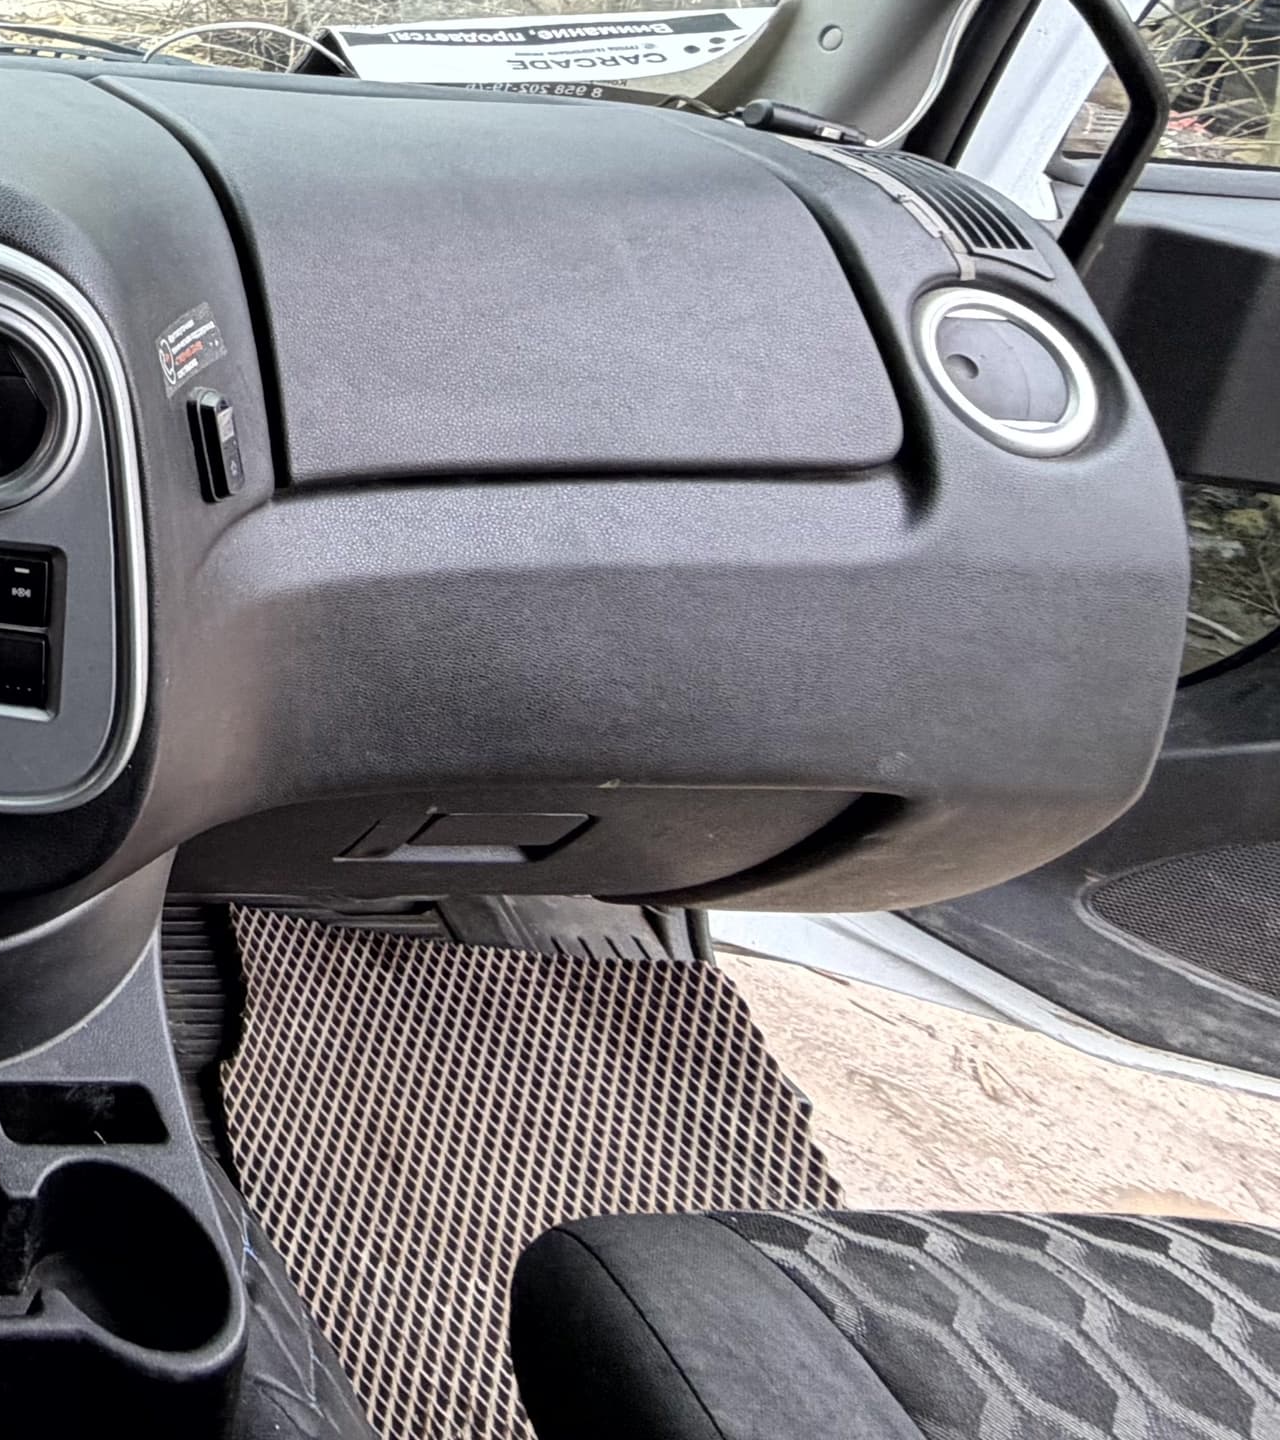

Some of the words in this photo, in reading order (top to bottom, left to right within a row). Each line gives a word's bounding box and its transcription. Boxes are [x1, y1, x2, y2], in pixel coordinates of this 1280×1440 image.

[388, 30, 526, 44] продается!
[529, 22, 674, 41] Внимание,
[506, 52, 669, 71] CARCADE
